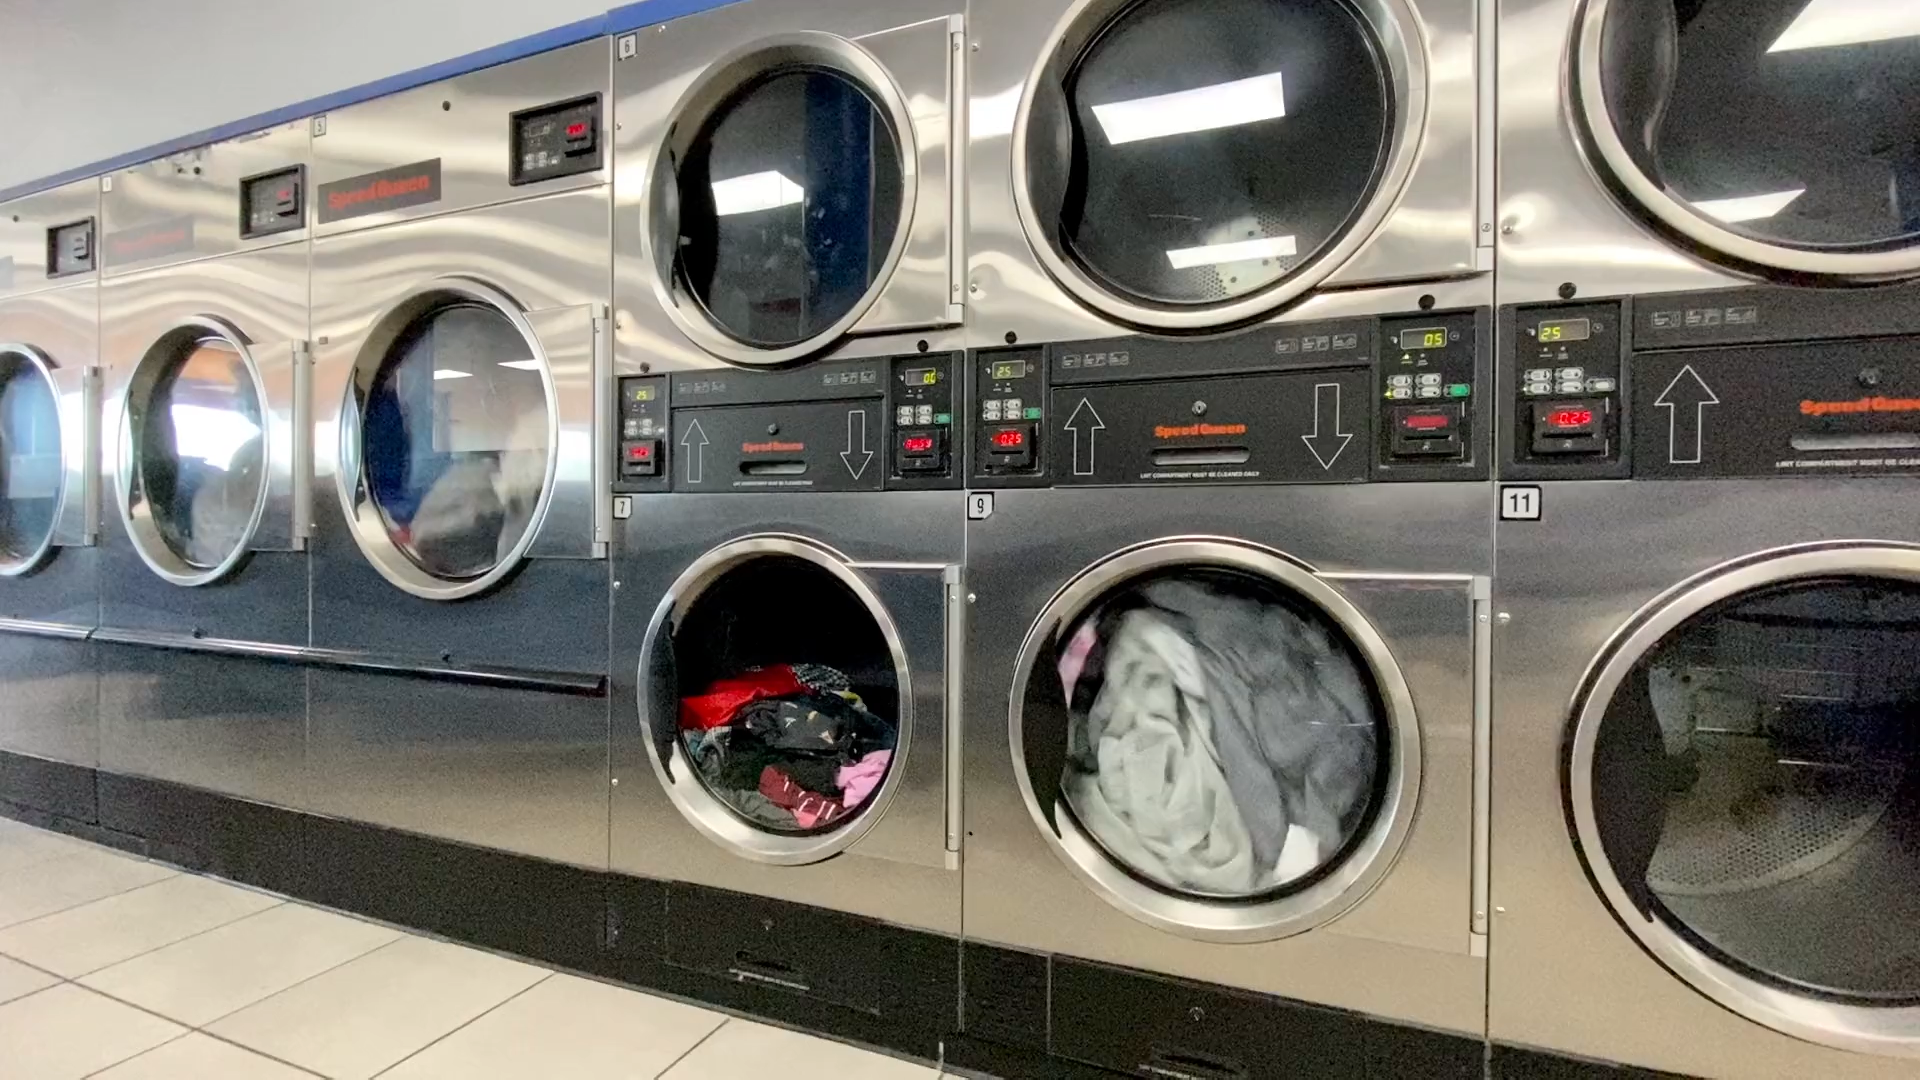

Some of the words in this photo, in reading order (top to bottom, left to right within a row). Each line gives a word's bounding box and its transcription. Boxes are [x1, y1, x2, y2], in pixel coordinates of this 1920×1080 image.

[624, 39, 631, 54] 6
[1423, 332, 1443, 347] 05
[1541, 326, 1561, 340] 25
[996, 366, 1012, 378] 25
[635, 390, 648, 401] 25
[620, 500, 626, 515] 7
[976, 497, 985, 515] 9
[1509, 493, 1531, 513] 11
